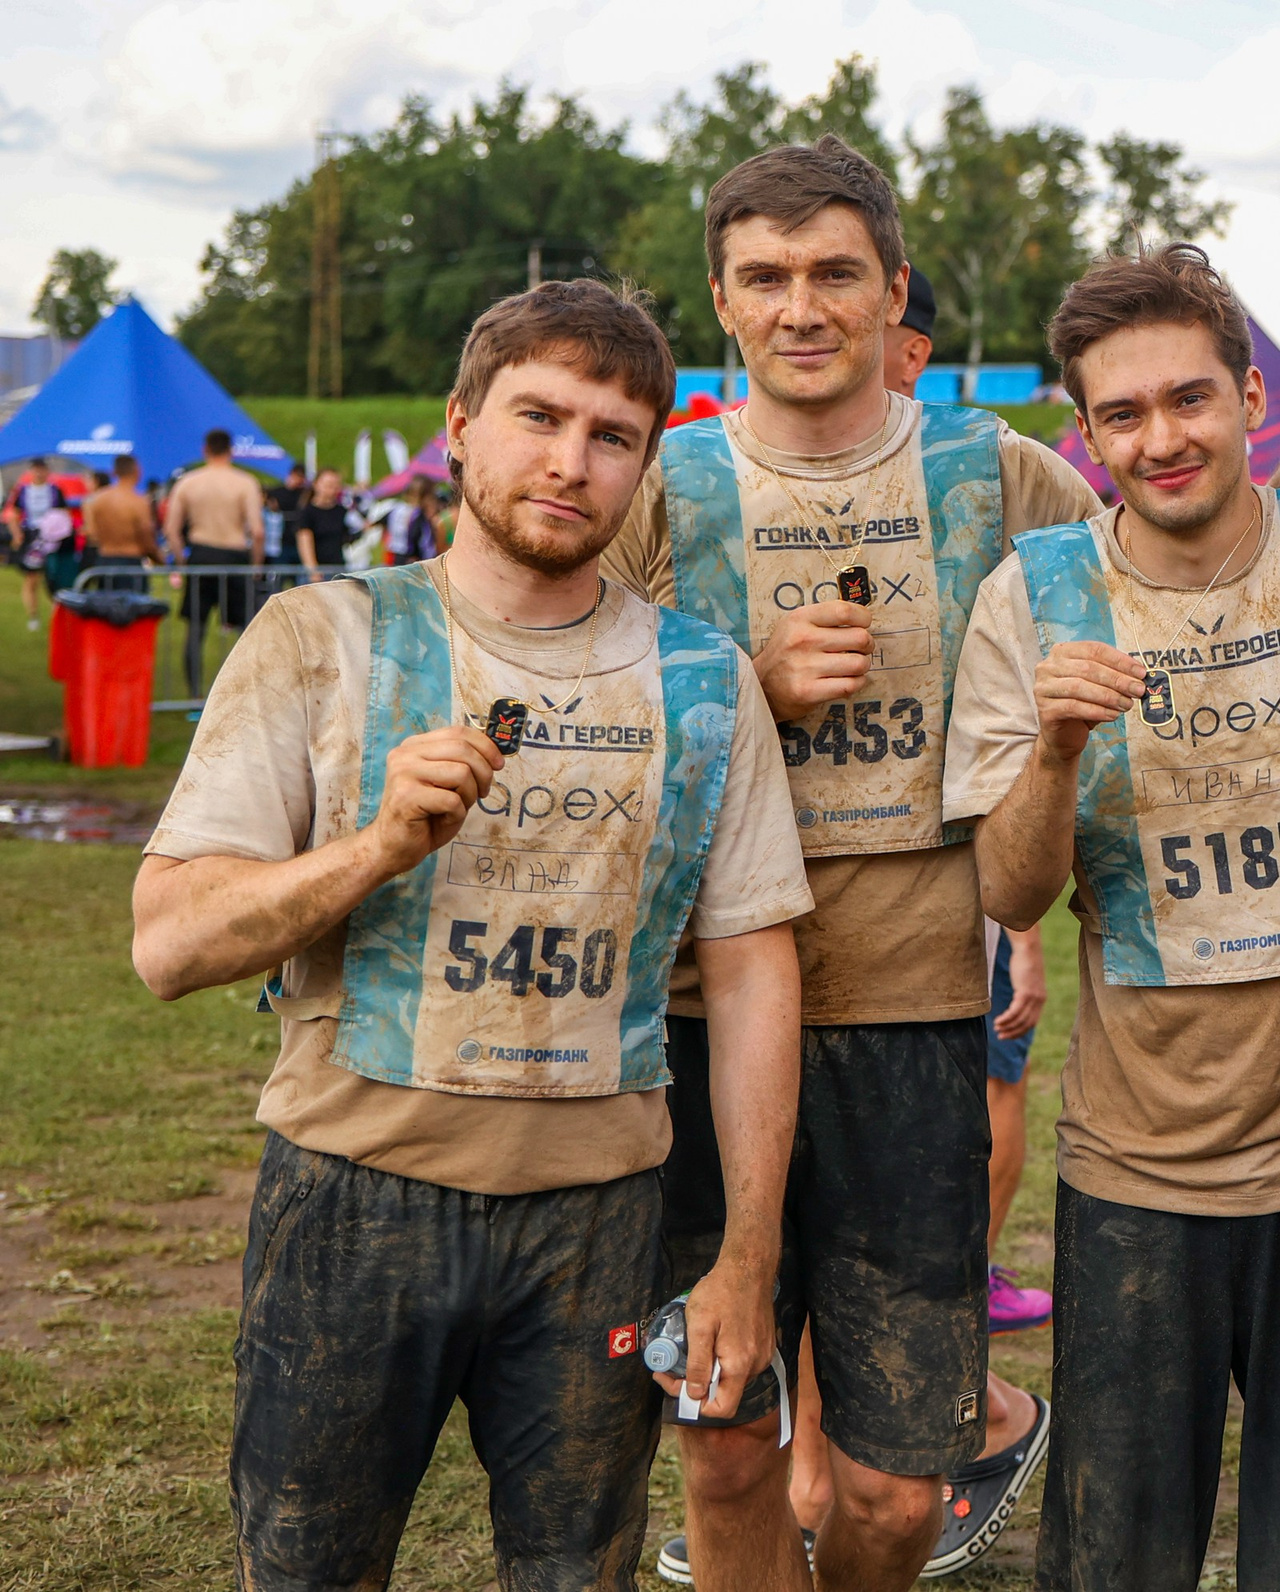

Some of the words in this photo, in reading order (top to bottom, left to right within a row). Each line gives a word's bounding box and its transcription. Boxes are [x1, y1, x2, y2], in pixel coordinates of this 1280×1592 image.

[754, 526, 831, 545] ГОНКА
[838, 516, 920, 542] ГЕРОЕВ
[773, 572, 913, 611] ax
[464, 713, 550, 742] ГКА
[559, 723, 654, 747] ГЕРОЕВ
[776, 697, 927, 767] 5453
[1171, 768, 1272, 803] ИВАН
[476, 782, 636, 828] apex
[822, 804, 912, 823] ГАЗПРОМБАНК
[444, 919, 618, 999] 5450
[489, 1046, 589, 1064] ГАЗПРОМБАНК
[968, 1493, 1016, 1557] crocs
